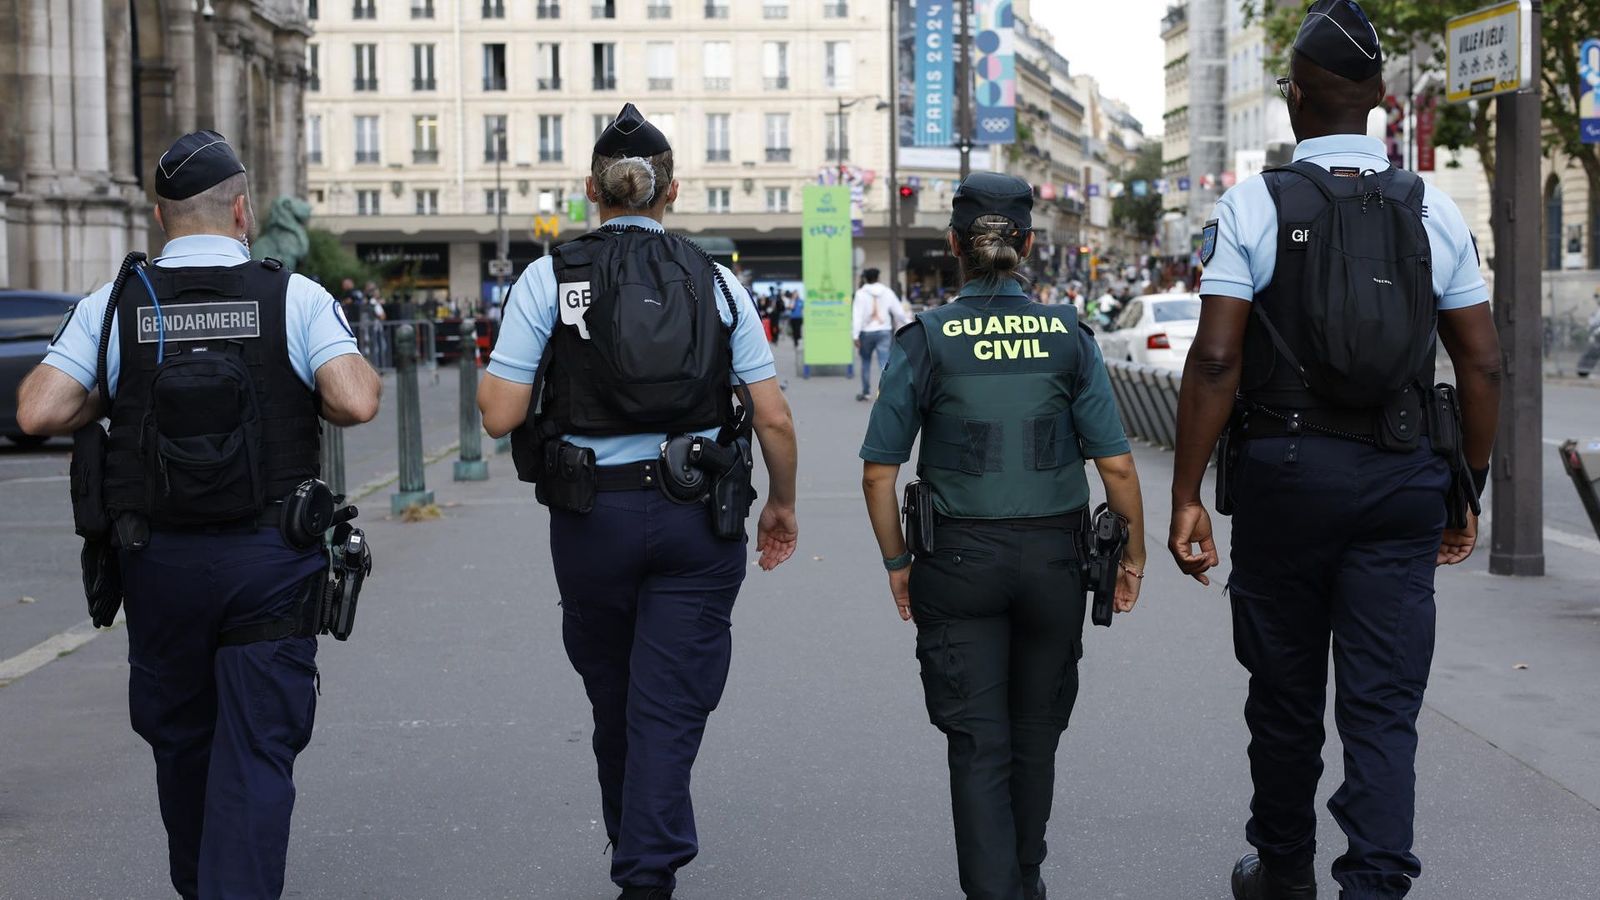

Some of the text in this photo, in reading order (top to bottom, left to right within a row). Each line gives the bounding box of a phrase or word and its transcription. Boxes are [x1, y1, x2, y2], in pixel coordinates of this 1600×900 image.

[1459, 32, 1478, 54] VILLE
[926, 4, 943, 134] PARIS 2024
[534, 214, 560, 240] M
[141, 311, 256, 333] GENDARMERIE
[942, 315, 1069, 337] GUARDIA
[973, 338, 1049, 360] CIVIL
